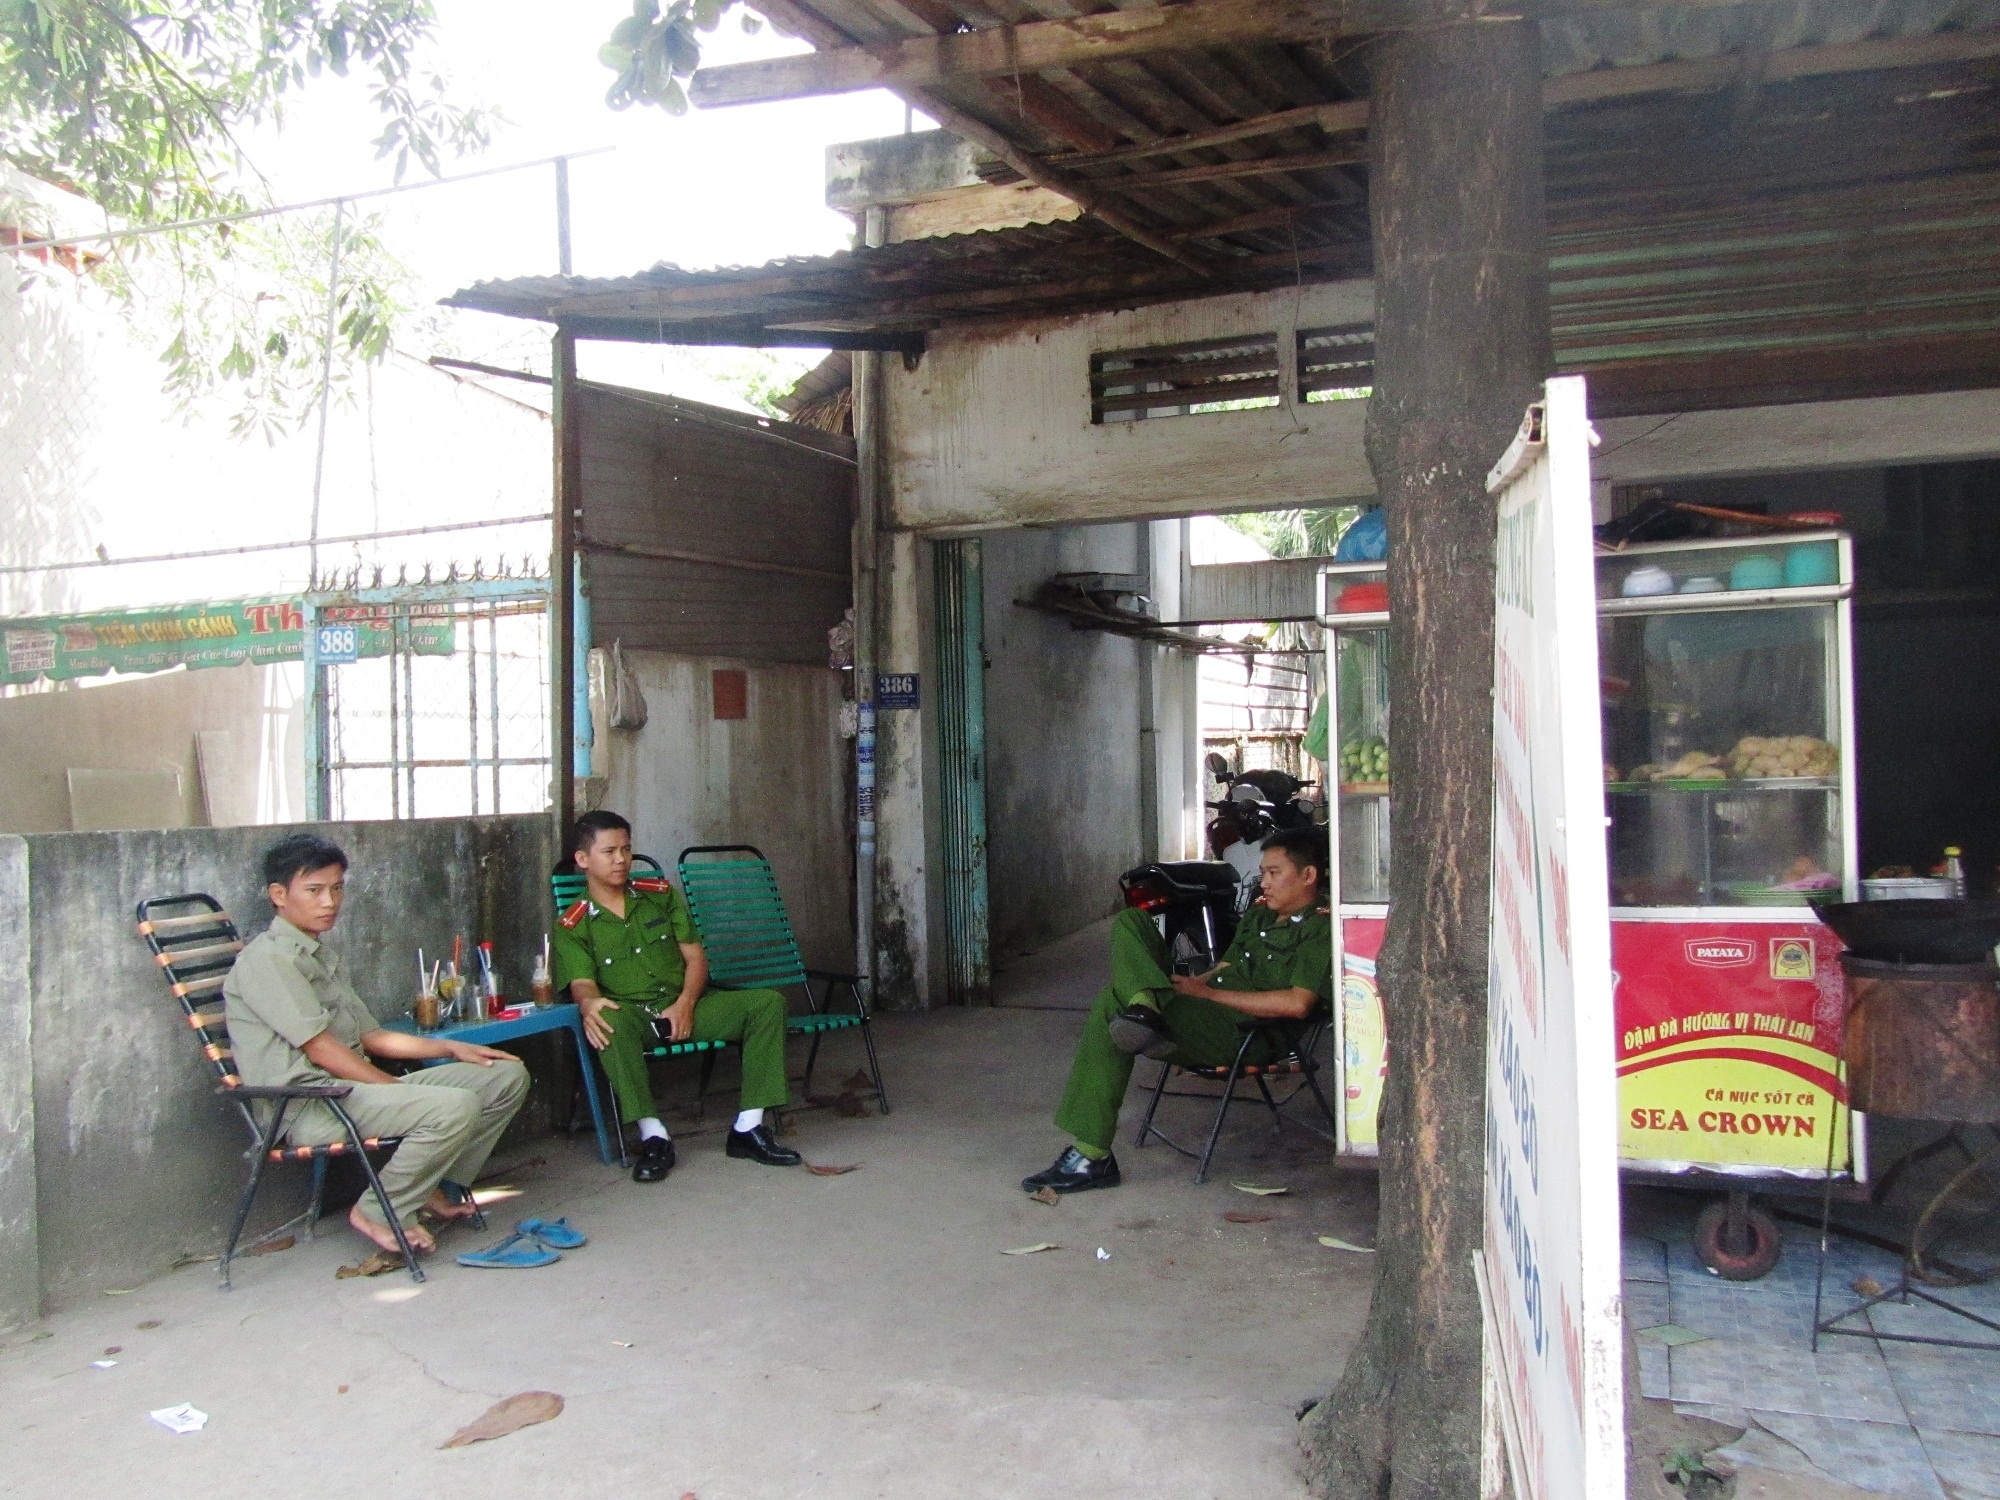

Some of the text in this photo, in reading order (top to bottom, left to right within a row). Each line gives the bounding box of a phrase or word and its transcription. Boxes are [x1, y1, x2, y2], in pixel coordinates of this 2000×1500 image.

[320, 630, 354, 653] 388
[880, 676, 913, 693] 386
[1696, 948, 1744, 958] PATAYA
[1624, 1011, 1816, 1050] ĐẬM ĐÀ HƯƠNG VỊ THÁI LAN
[1729, 1091, 1759, 1105] NỤC
[1630, 1108, 1816, 1138] SEA CROWN
